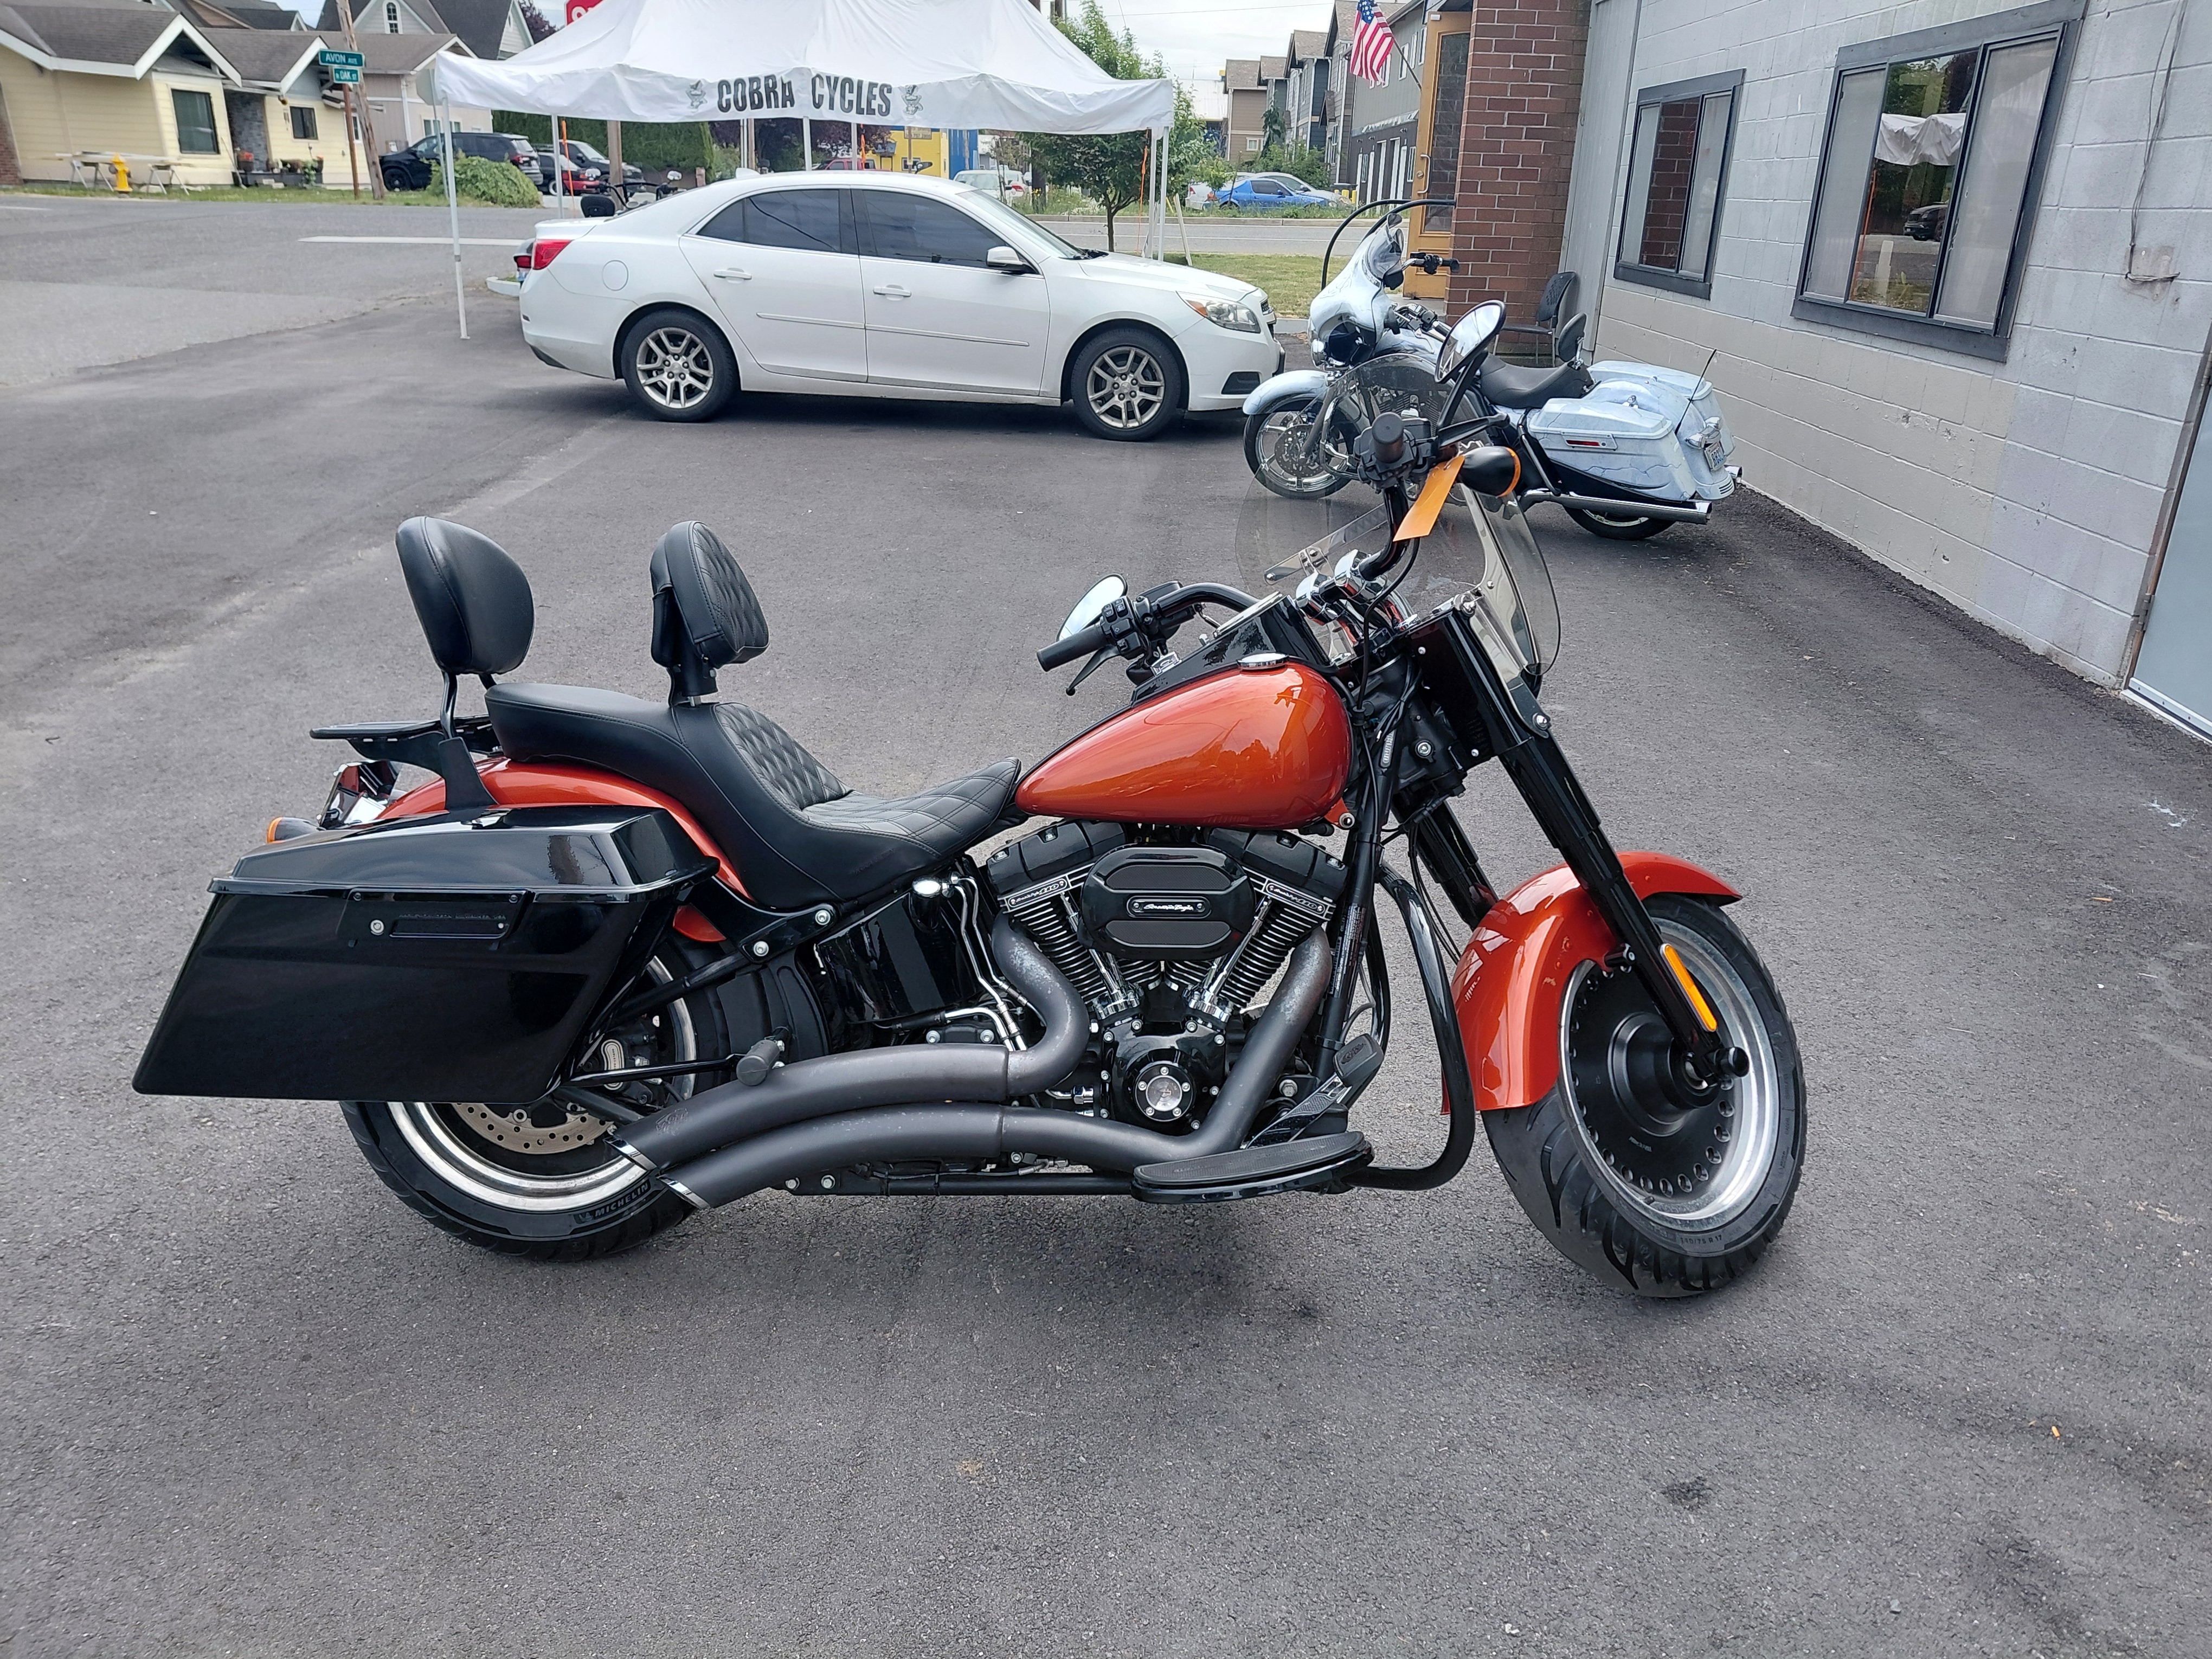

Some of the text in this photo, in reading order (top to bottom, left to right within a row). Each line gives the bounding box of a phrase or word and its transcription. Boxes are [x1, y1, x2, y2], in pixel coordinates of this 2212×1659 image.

[325, 53, 346, 63] AVON
[339, 70, 351, 80] OAK
[717, 73, 892, 117] COBRA CYCLES
[595, 1182, 648, 1217] MICHELIN
